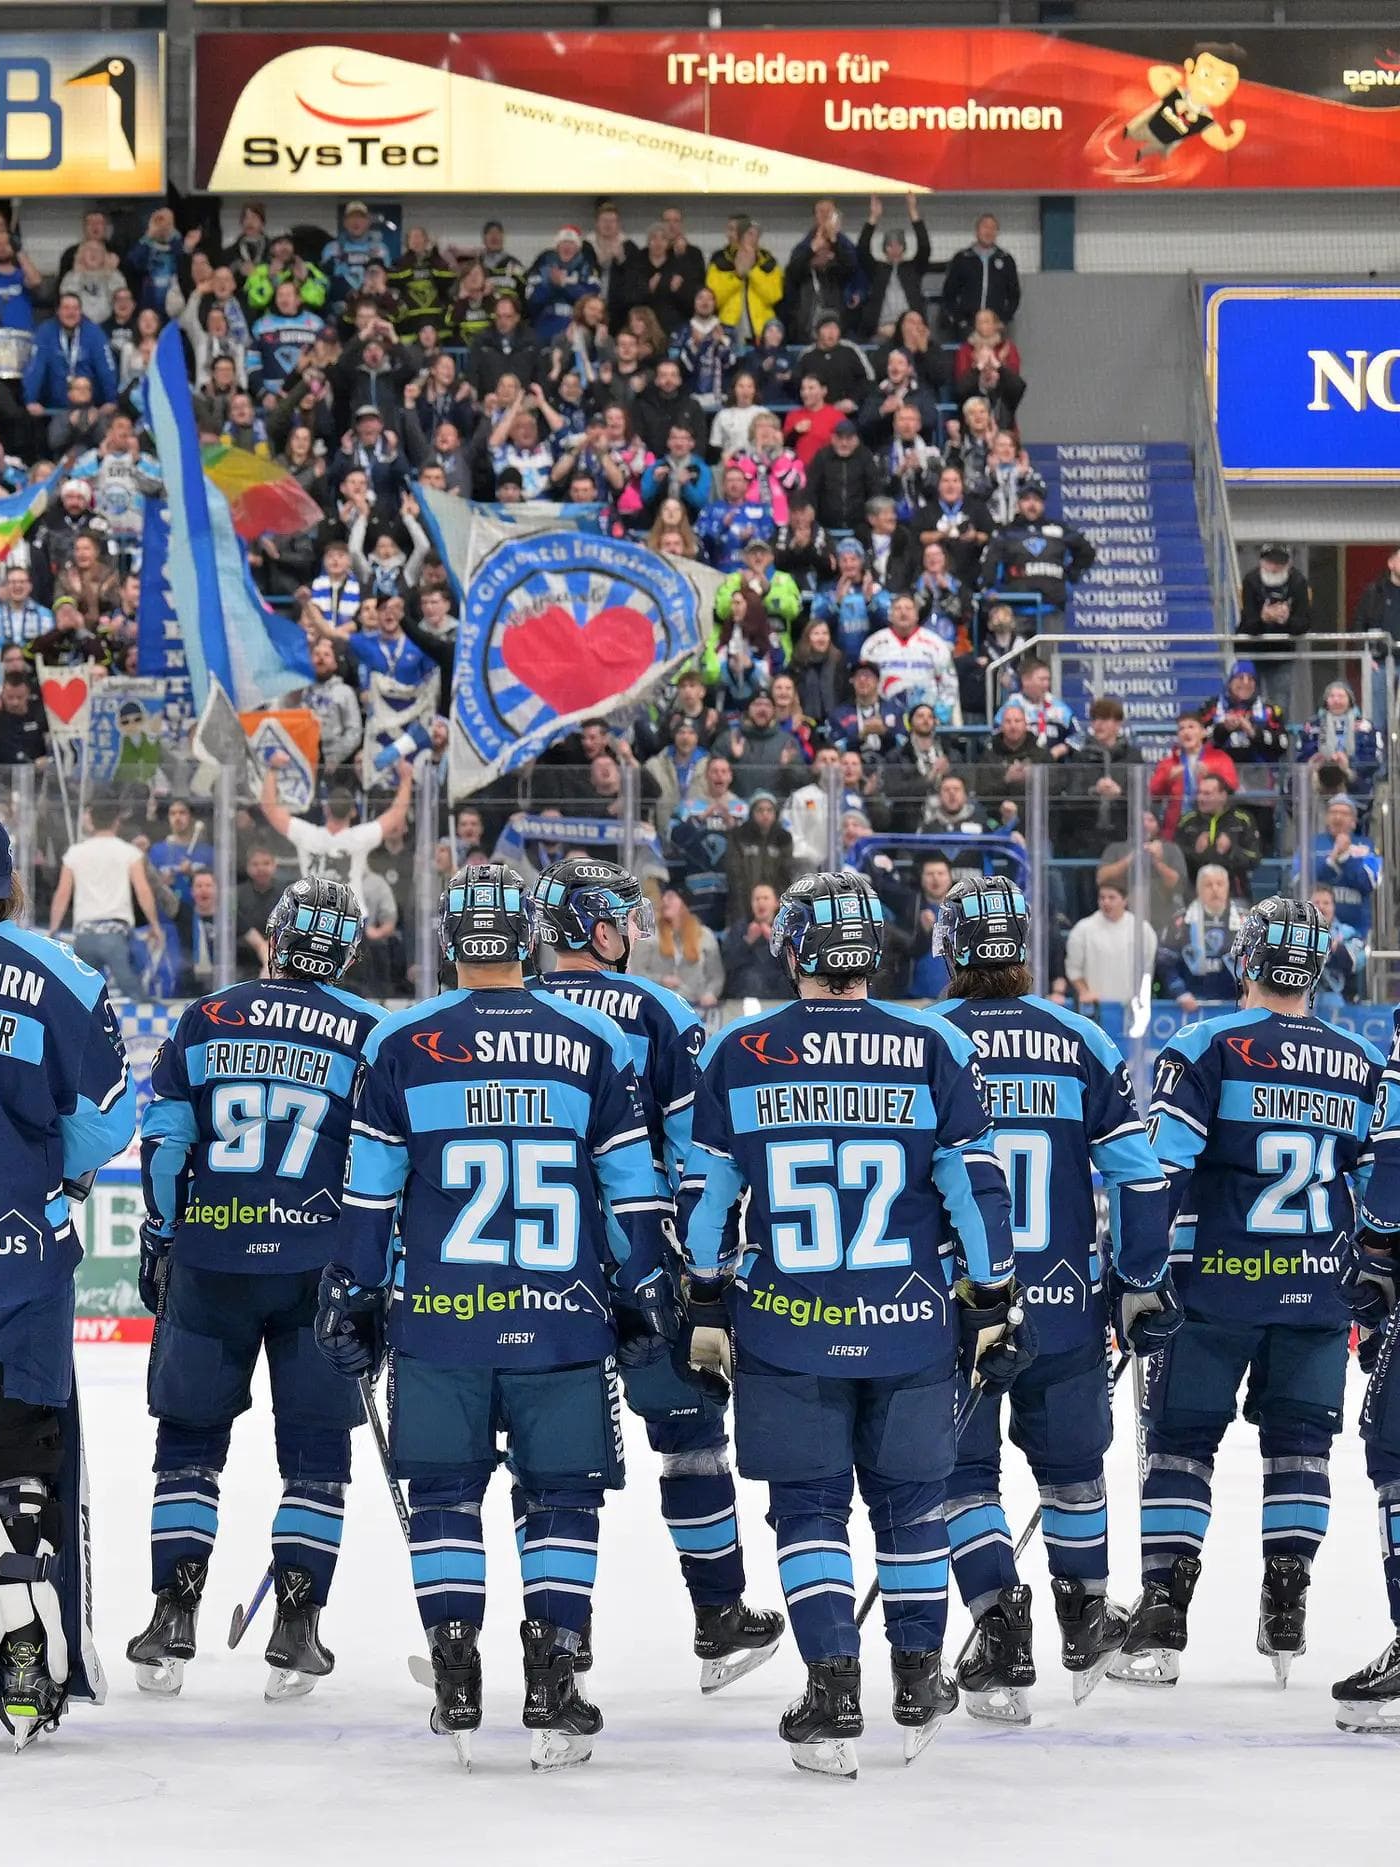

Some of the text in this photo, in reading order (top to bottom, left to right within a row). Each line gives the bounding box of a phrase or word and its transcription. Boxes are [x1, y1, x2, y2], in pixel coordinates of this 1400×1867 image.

[667, 53, 890, 86] IT-Helden für
[824, 99, 1063, 132] Unternehmen
[242, 138, 440, 173] SysTec
[475, 888, 492, 903] 25
[841, 899, 859, 914] 52
[319, 915, 335, 930] 67
[473, 919, 494, 928] ERC
[842, 930, 862, 940] ERC
[248, 999, 357, 1048] SATURN
[554, 987, 642, 1021] ATURN
[205, 1040, 332, 1087] FRIEDRICH
[475, 1030, 591, 1076] SATURN
[802, 1031, 924, 1068] SATURN
[975, 1028, 1080, 1066] SATURN
[465, 1081, 554, 1127] HÜTTL
[755, 1087, 917, 1127] HENRIQUEZ
[1251, 1086, 1357, 1132] SIMPSON
[991, 1129, 1053, 1253] 0
[1245, 1131, 1338, 1236] 21
[440, 1138, 581, 1272] 25
[765, 1138, 912, 1274] 52
[751, 1283, 934, 1326] zieglerhaus
